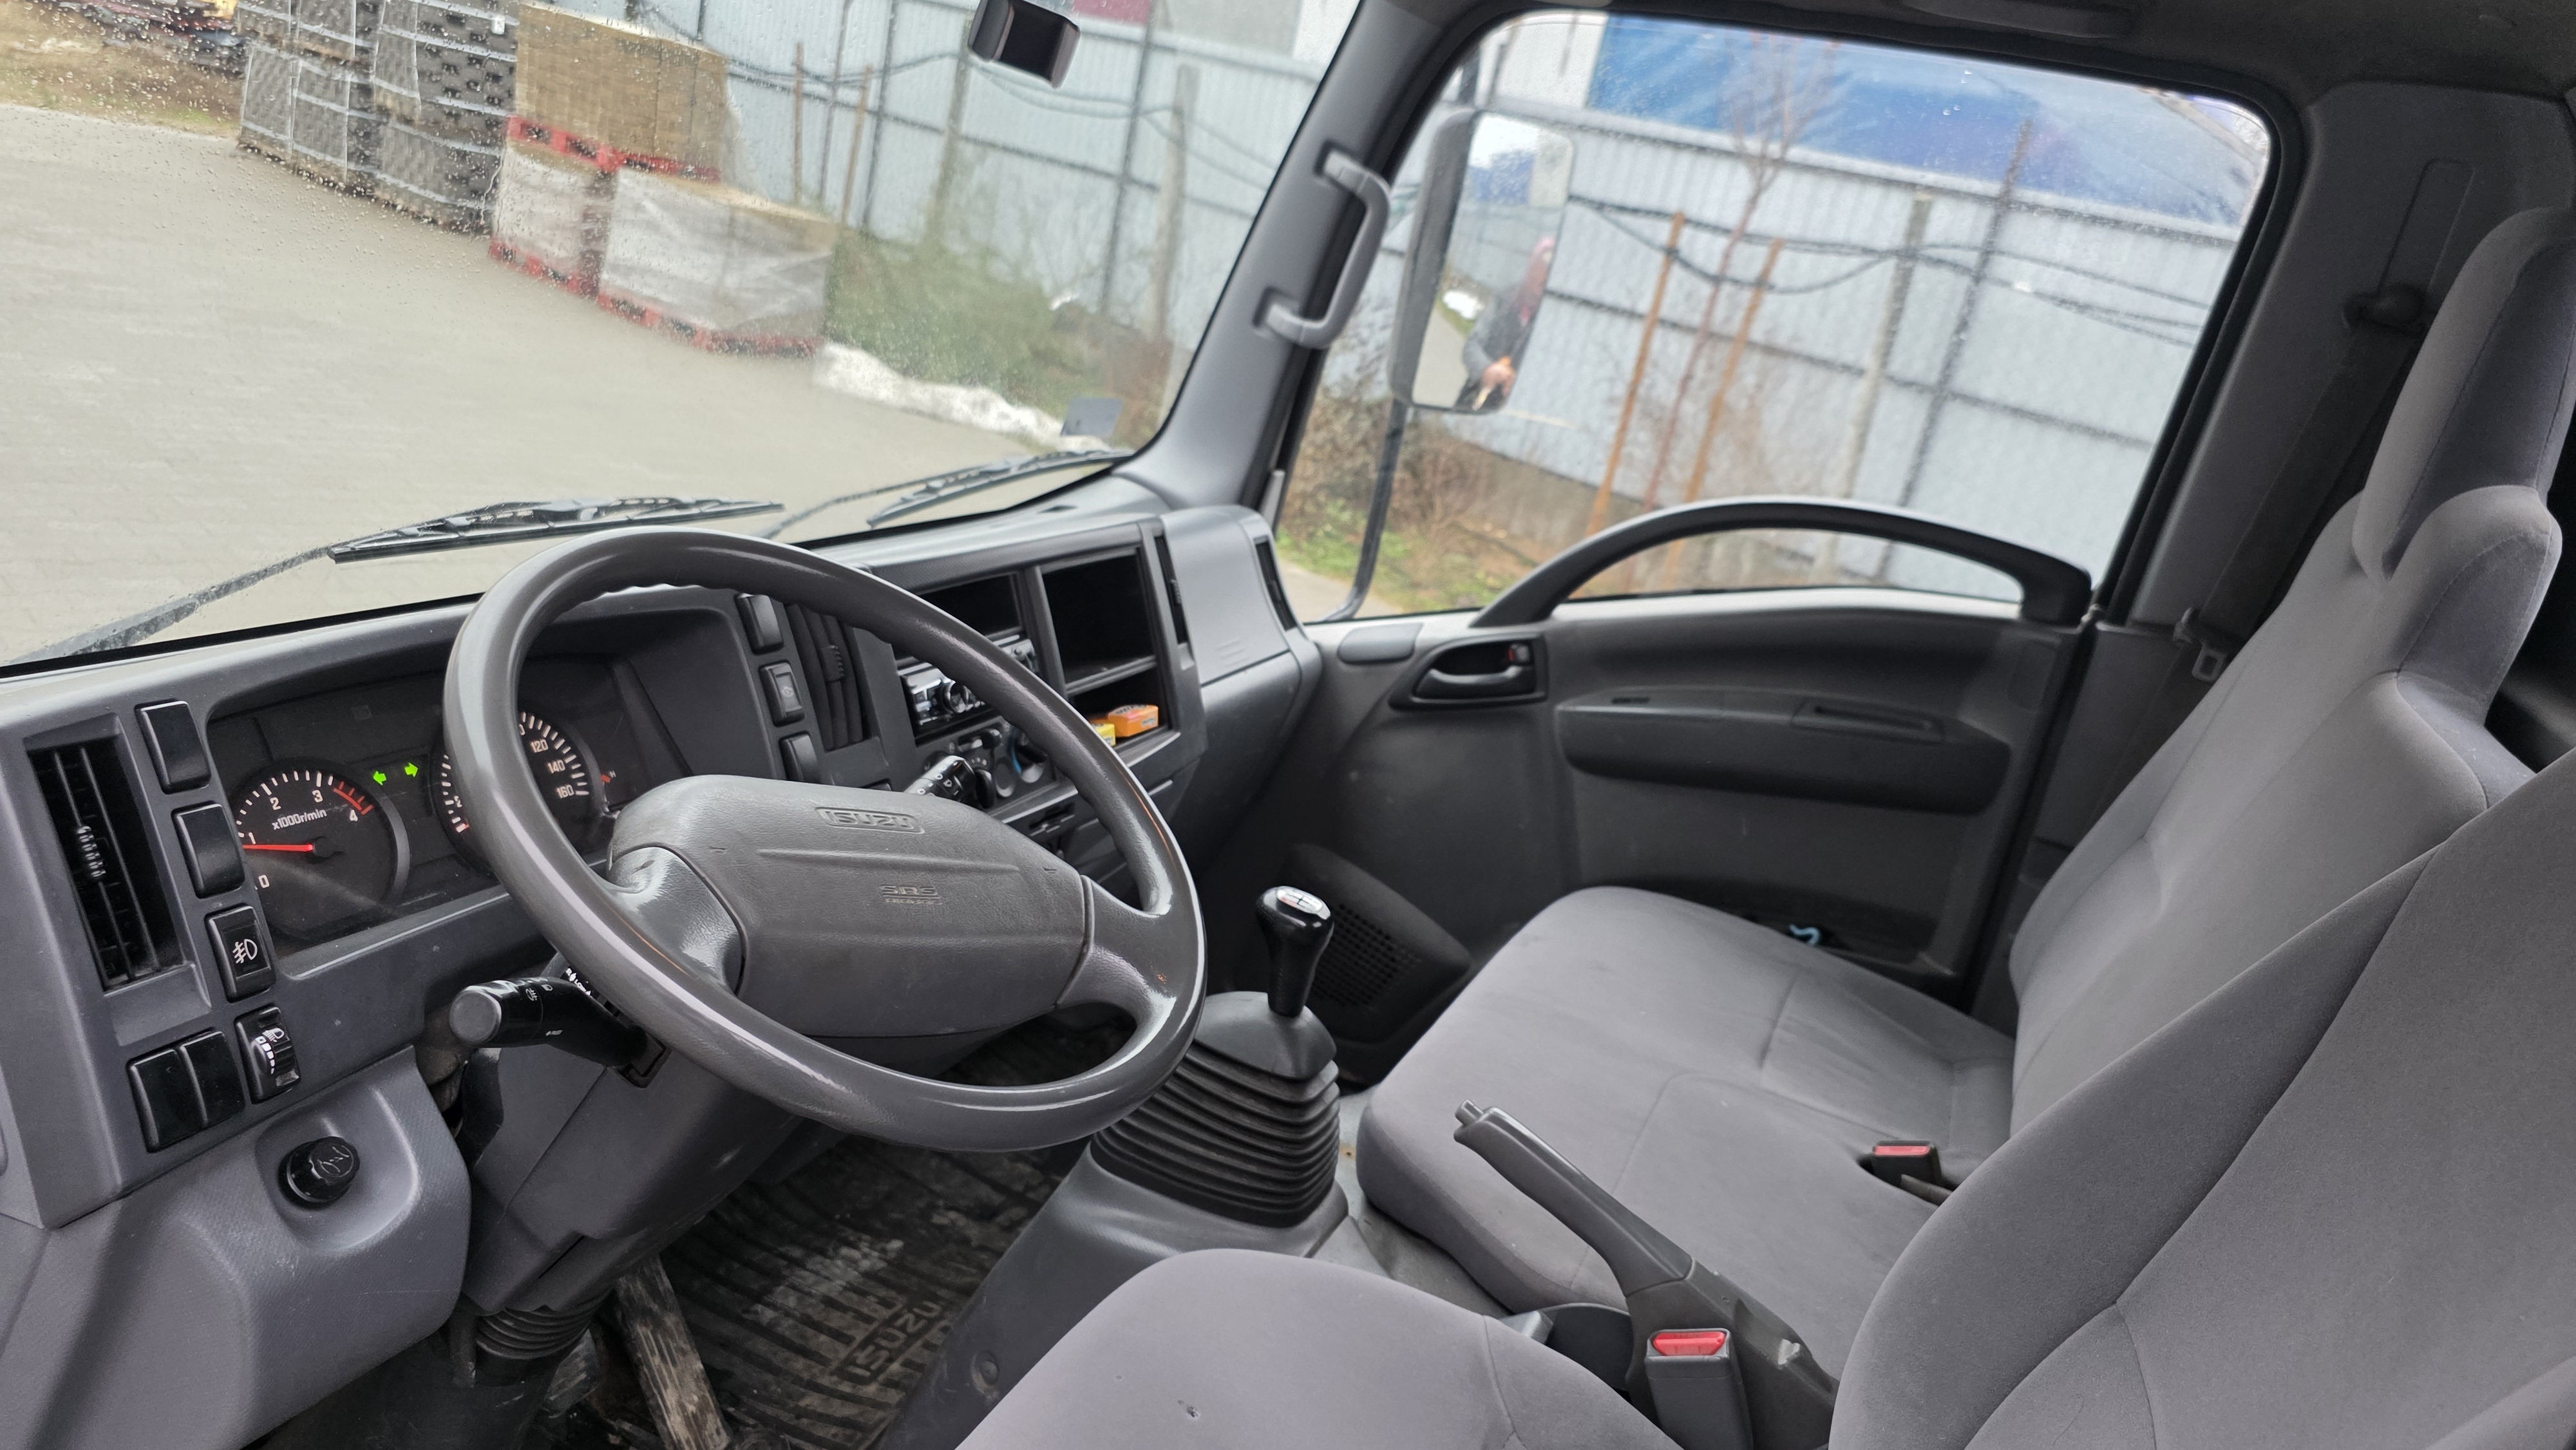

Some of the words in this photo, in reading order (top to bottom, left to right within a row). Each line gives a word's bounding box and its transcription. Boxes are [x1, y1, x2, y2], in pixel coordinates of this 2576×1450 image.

[530, 739, 549, 753] 120
[547, 759, 566, 774] 140
[312, 789, 323, 803] 3
[556, 784, 574, 798] 160
[269, 796, 281, 811] 2
[271, 809, 327, 830] x1000r/min
[349, 809, 358, 822] 4
[824, 811, 915, 830] ISUZU
[248, 832, 256, 845] 1
[258, 874, 270, 889] 0
[879, 884, 938, 896] SRS
[845, 1300, 942, 1377] ISUZU
